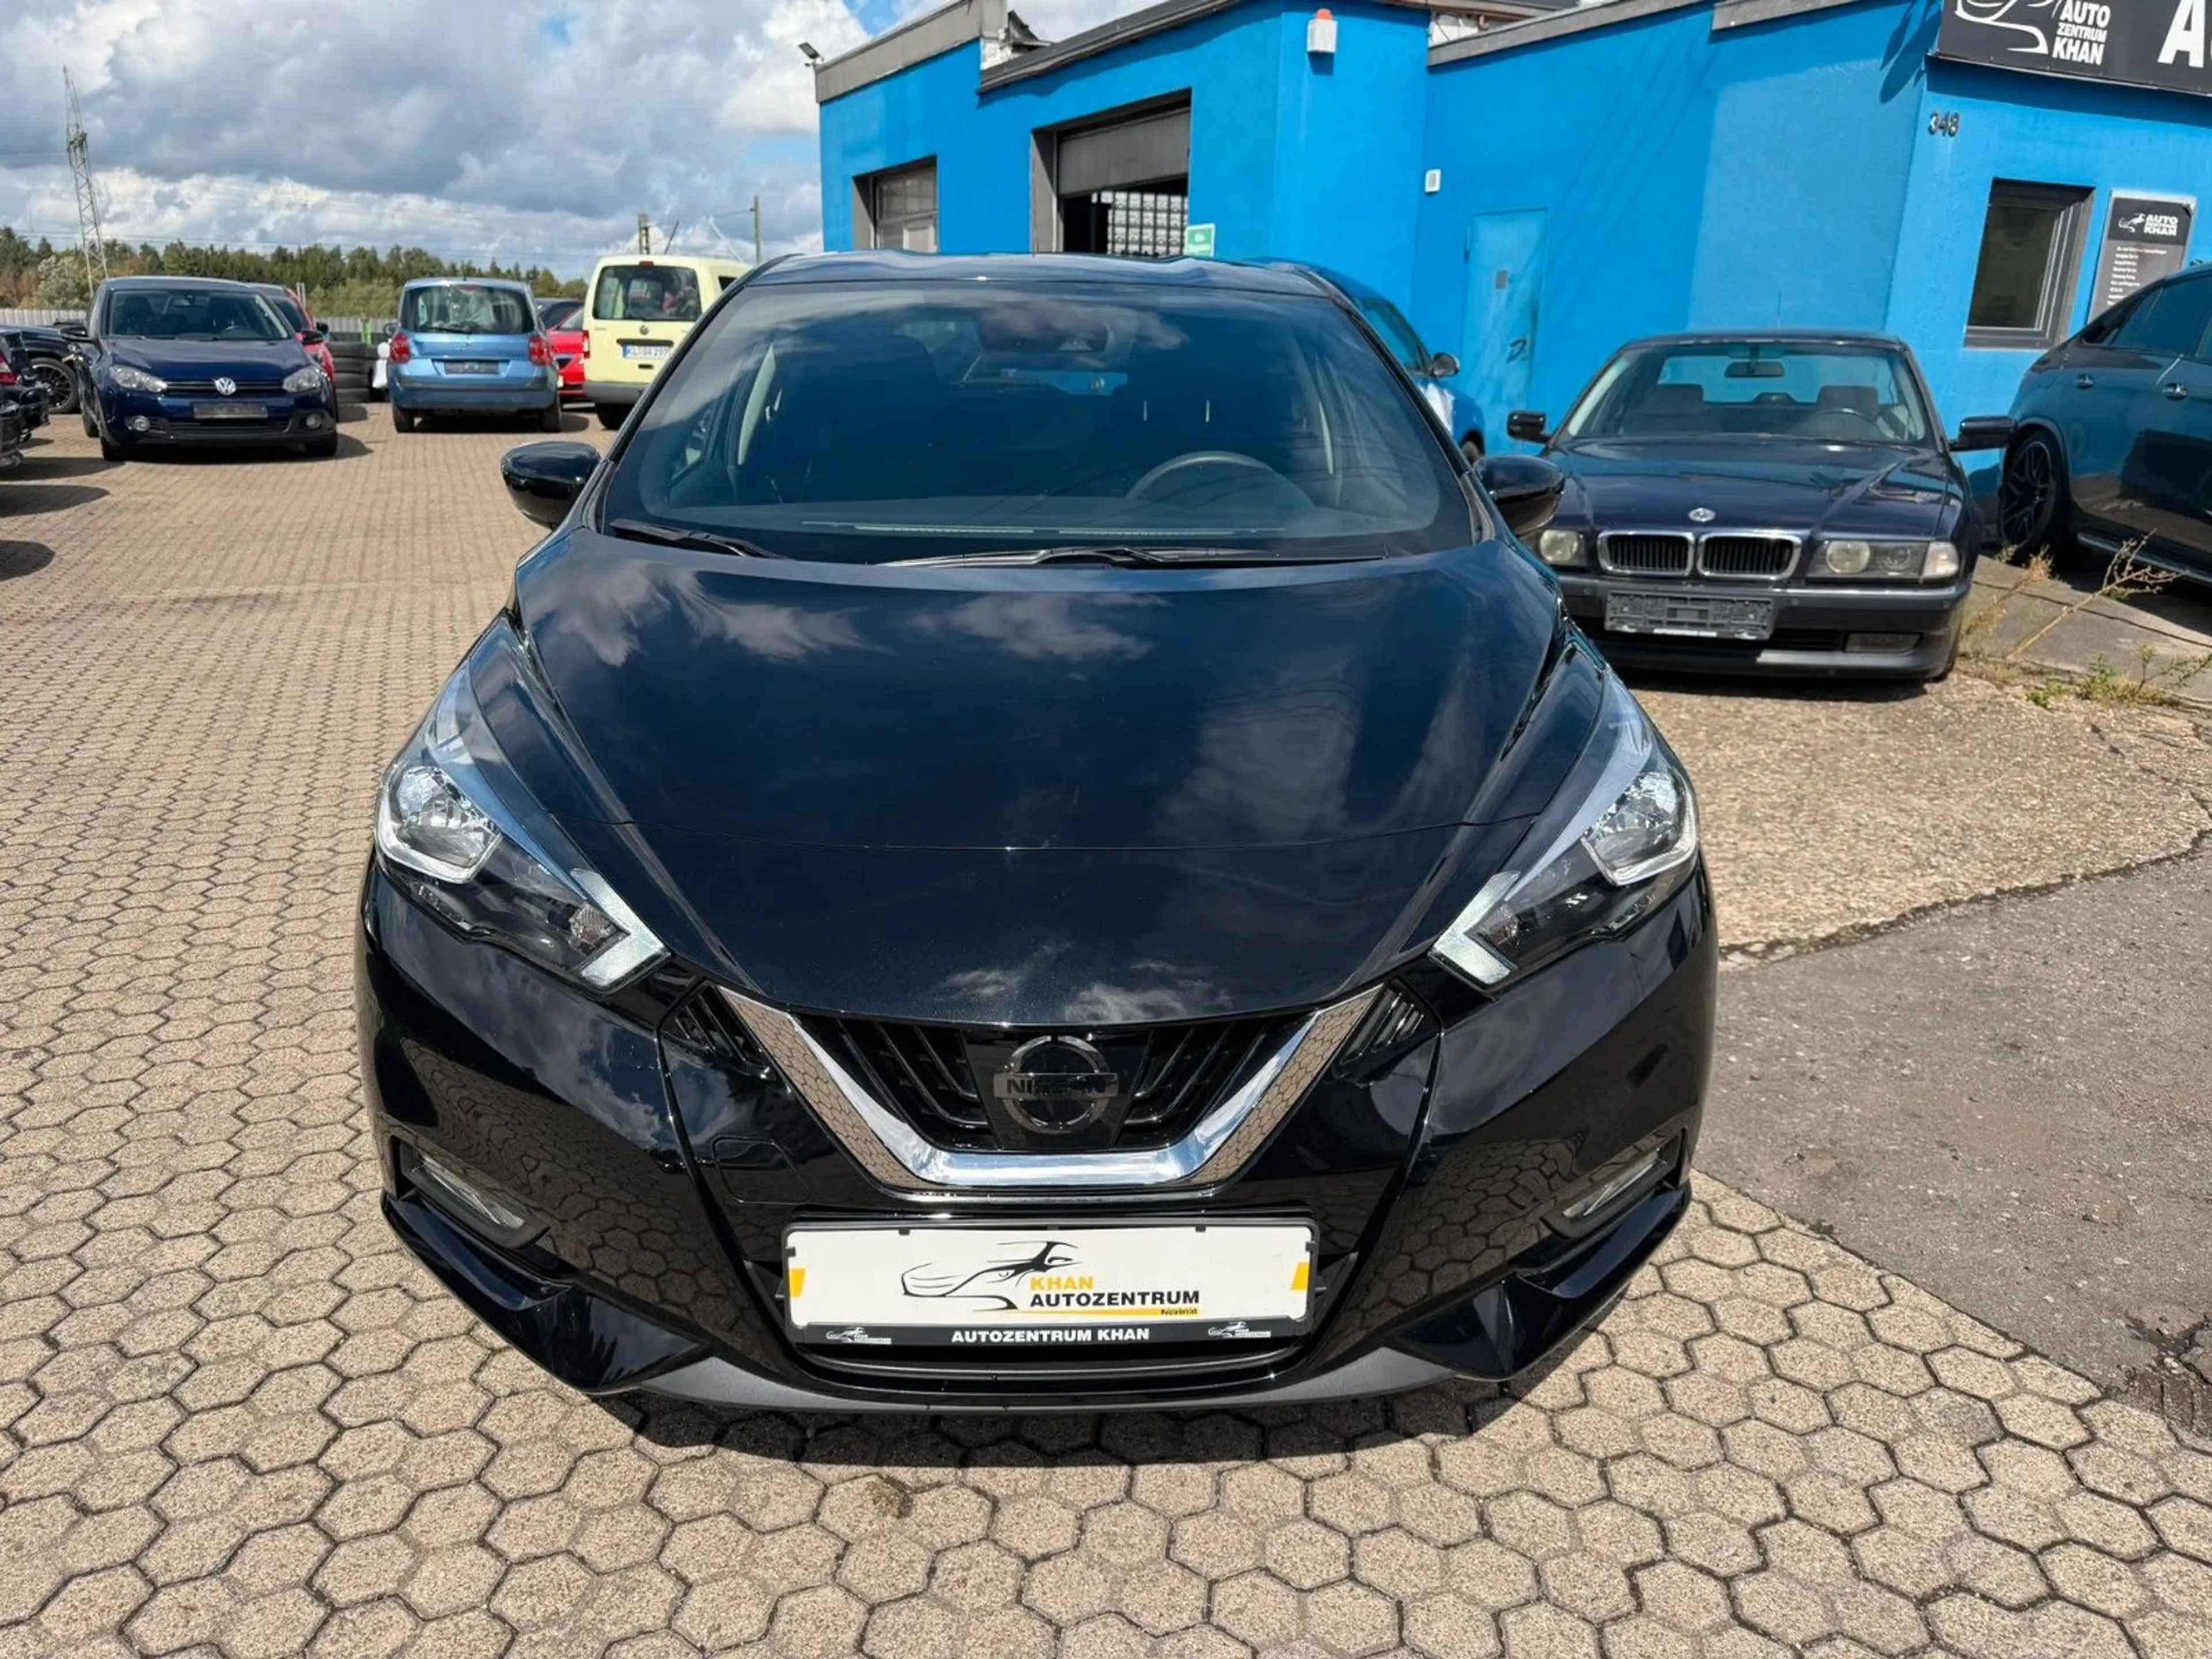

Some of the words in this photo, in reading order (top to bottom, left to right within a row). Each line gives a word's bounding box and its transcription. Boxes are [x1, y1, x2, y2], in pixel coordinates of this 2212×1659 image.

[2060, 0, 2111, 28] AUTO
[2057, 22, 2107, 42] ZENTRUM
[2157, 0, 2212, 68] A
[2052, 36, 2105, 65] KHAN
[1928, 111, 1959, 137] 348
[2146, 214, 2179, 224] AUTO
[1006, 1079, 1106, 1094] NIN
[1030, 1276, 1093, 1290] KHAN
[1030, 1291, 1200, 1307] AUTOZENTRUM
[952, 1329, 1092, 1343] AUTOZENTRUM
[1097, 1328, 1150, 1341] KHAN
